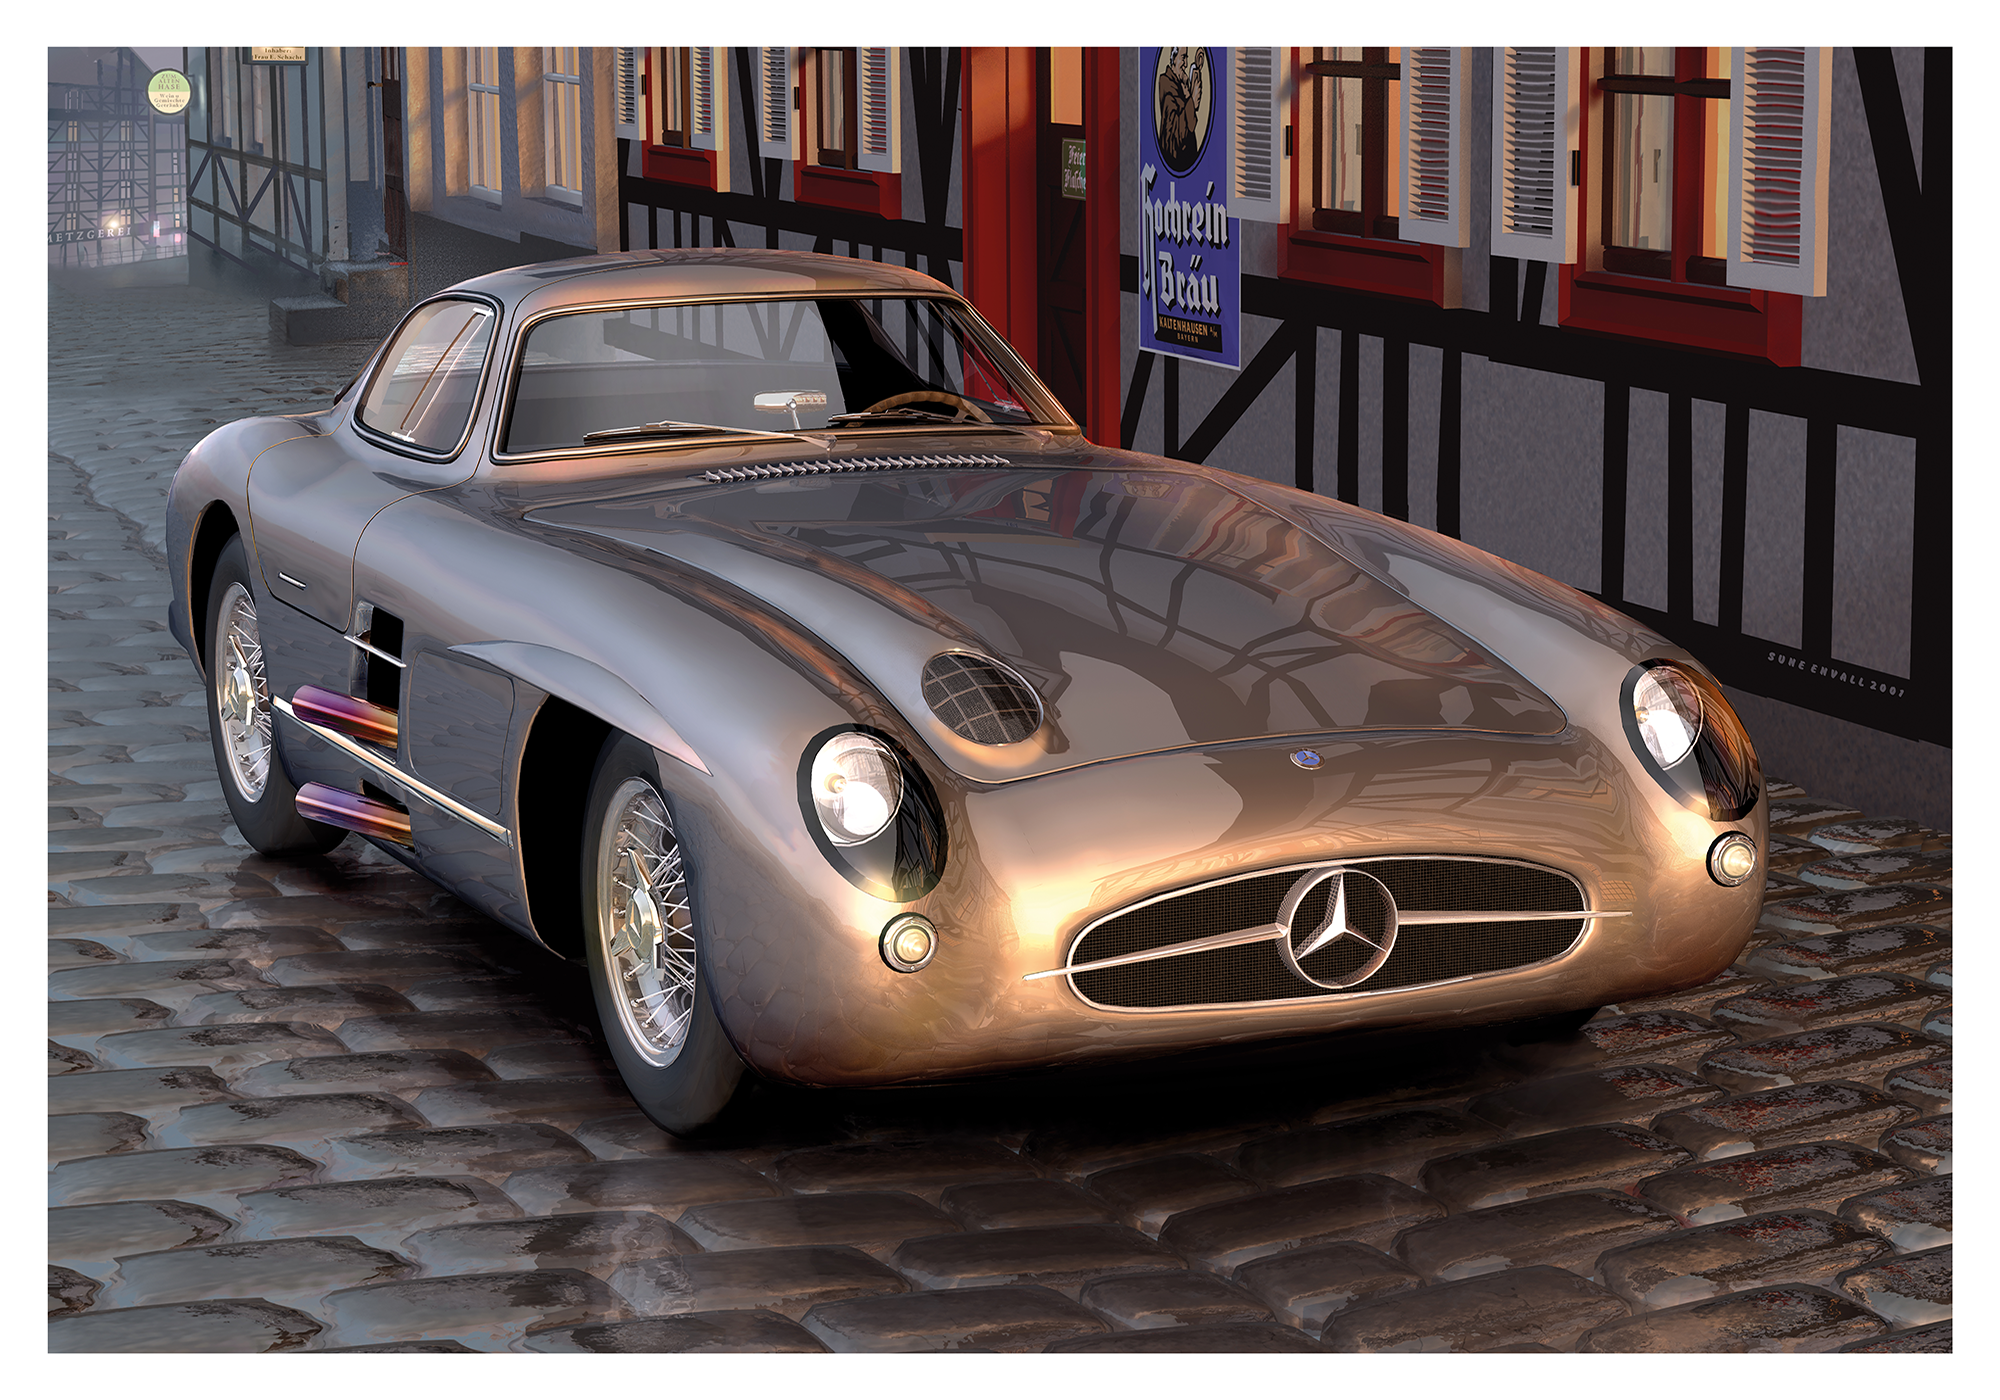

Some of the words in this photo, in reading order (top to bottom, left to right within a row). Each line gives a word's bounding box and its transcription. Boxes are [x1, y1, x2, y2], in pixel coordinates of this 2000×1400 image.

[1158, 251, 1220, 316] Bräu
[1159, 316, 1208, 336] KALTENHAUSEN
[1177, 332, 1199, 343] BAYERN
[1767, 651, 1806, 671] SUNE
[1810, 663, 1865, 687] ENVALL
